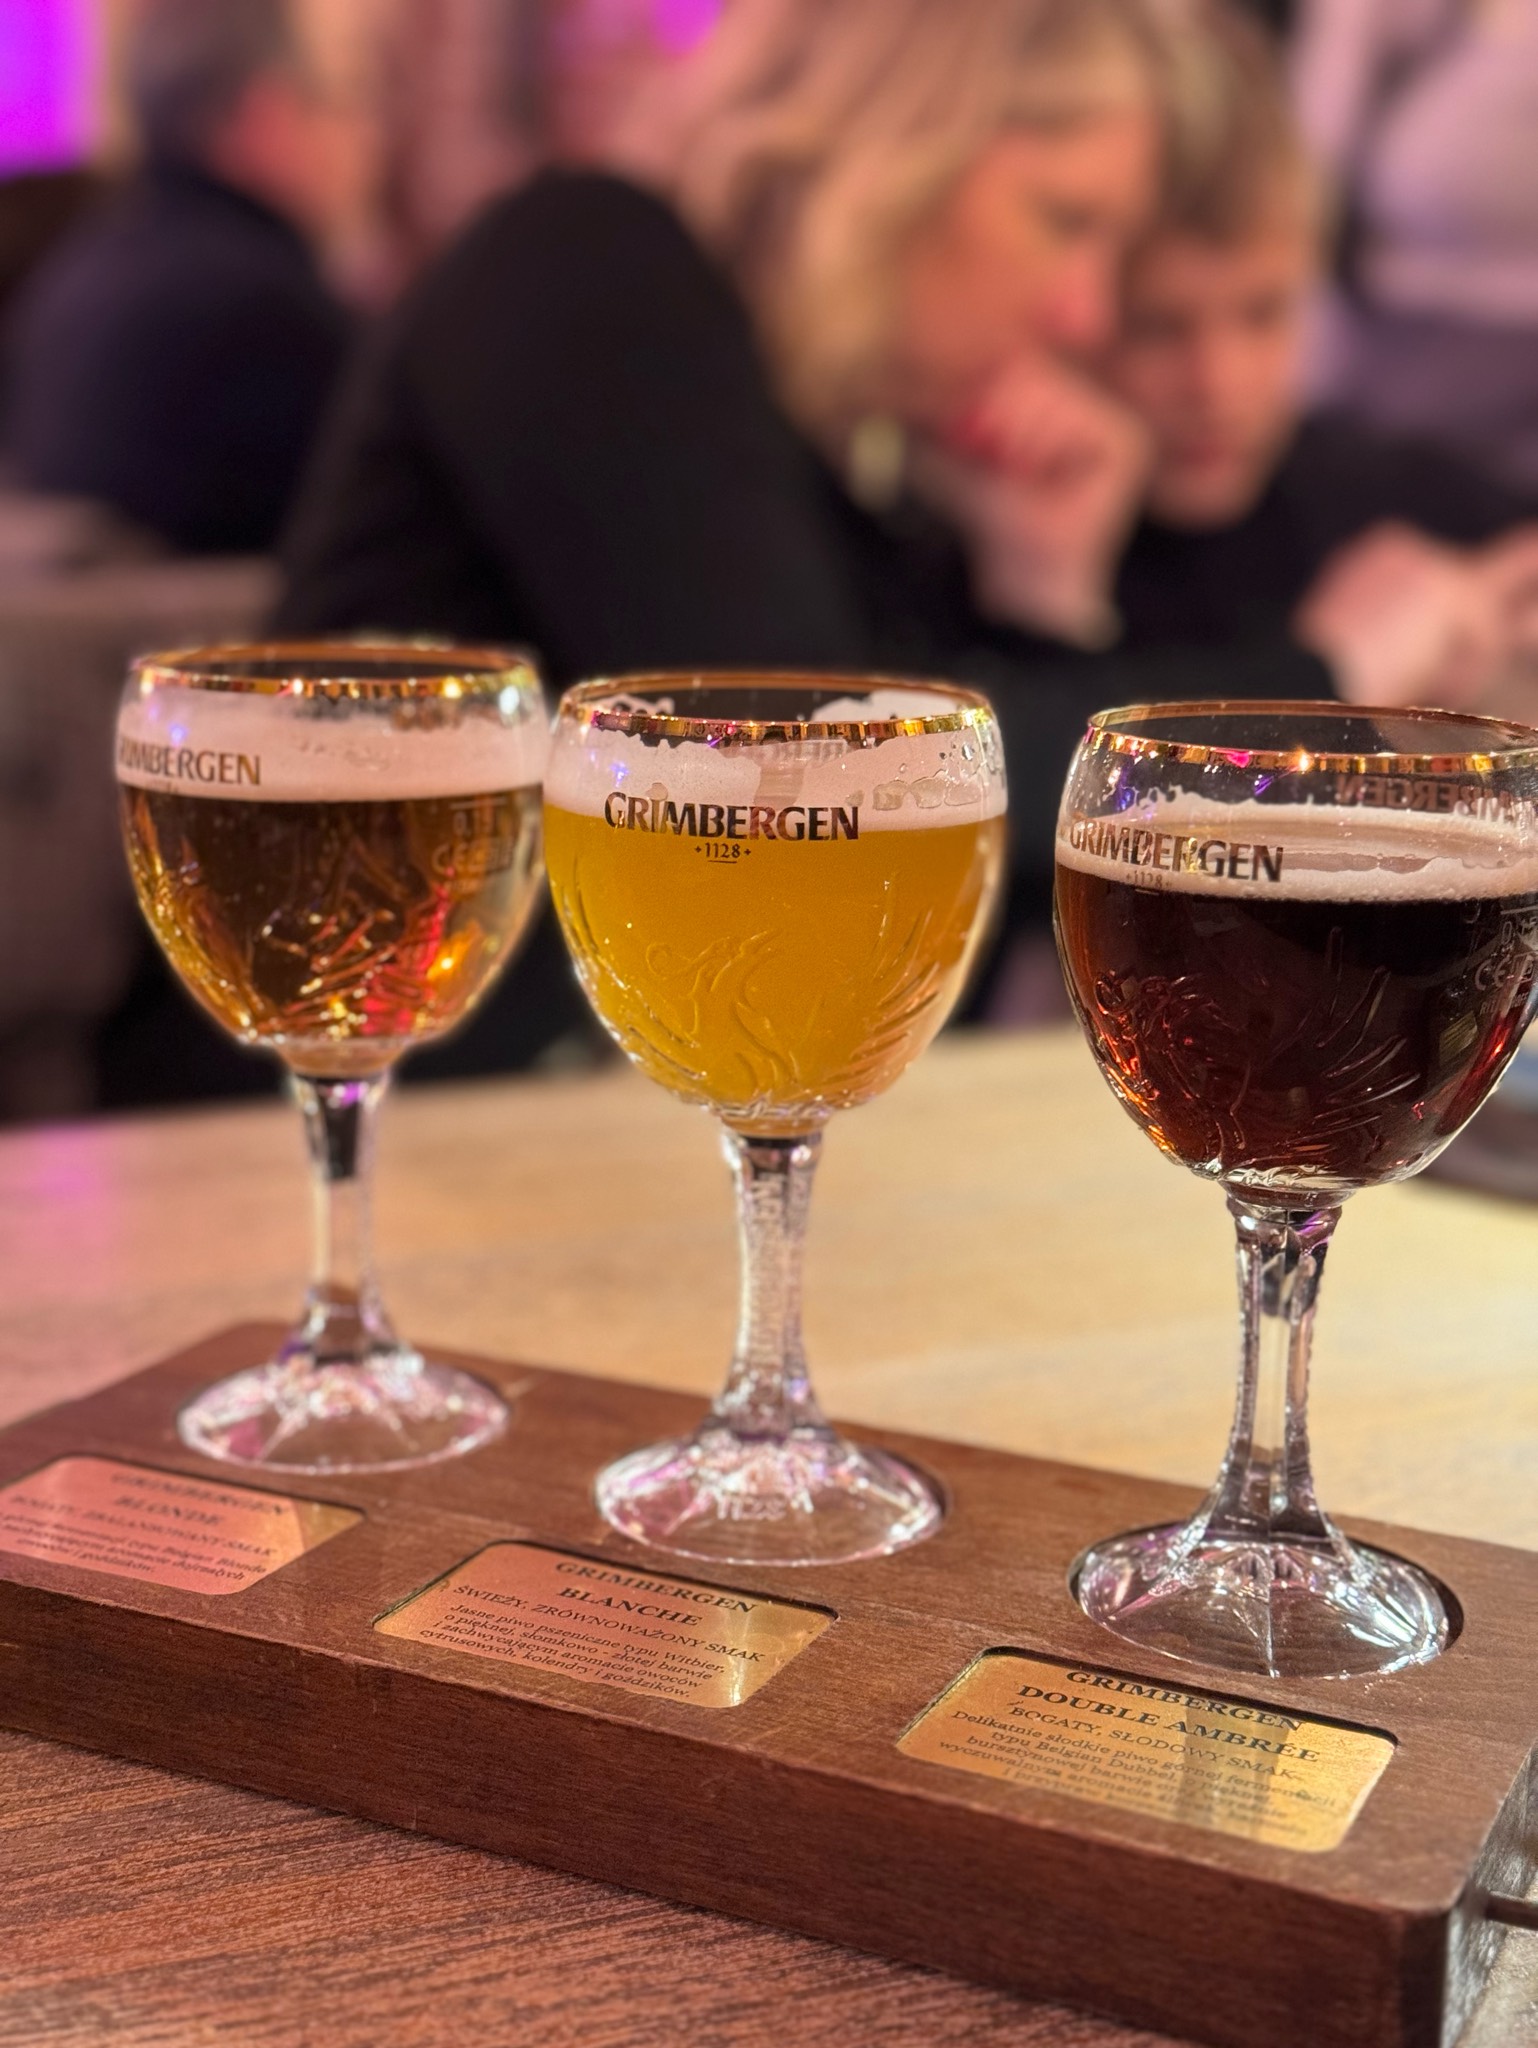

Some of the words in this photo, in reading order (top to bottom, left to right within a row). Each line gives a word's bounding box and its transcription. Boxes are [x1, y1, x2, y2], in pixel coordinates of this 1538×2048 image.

[604, 791, 859, 841] GRIMBERGEN
[705, 842, 741, 859] 1128
[1069, 818, 1284, 883] GRIMBERGEN
[557, 1564, 755, 1612] GRIMBERGEN
[560, 1588, 701, 1625] BLANCHE
[450, 1605, 494, 1619] Jasne
[494, 1616, 534, 1628] piwo
[535, 1625, 620, 1648] pszeniczne
[623, 1644, 658, 1656] typu
[665, 1652, 724, 1673] Witbier,
[453, 1586, 527, 1609] ŚWIEŻY,
[532, 1605, 704, 1646] ZRÓWNOWAŻONY
[705, 1644, 764, 1661] SMAK
[454, 1617, 515, 1635] pięknej,
[520, 1631, 597, 1653] słomkowo
[612, 1652, 657, 1667] złotej
[658, 1661, 712, 1679] barwie
[420, 1630, 516, 1657] cytrusowych,
[522, 1650, 592, 1674] kolendry
[601, 1673, 689, 1697] goździków.
[442, 1625, 558, 1654] zachwycającym
[561, 1652, 633, 1672] aromacie
[637, 1670, 701, 1687] owoców
[1018, 1686, 1159, 1725] DOUBLE
[1166, 1721, 1319, 1762] AMBRÉE
[1067, 1672, 1300, 1730] GRIMBERGEN
[952, 1711, 1042, 1737] Delikatnie
[1045, 1734, 1110, 1753] słodkie
[1113, 1750, 1158, 1764] piwo
[1160, 1762, 1223, 1780] górnej
[1226, 1775, 1335, 1805] fermenacji
[967, 1736, 1086, 1771] bursztynowej
[1090, 1765, 1152, 1786] barwie
[992, 1732, 1030, 1746] typu
[1035, 1741, 1102, 1763] Belgian
[1107, 1759, 1176, 1782] Dubbel,
[1009, 1707, 1101, 1735] BOGATY,
[1109, 1730, 1223, 1761] SŁODOWY
[1227, 1758, 1295, 1779] SMAK
